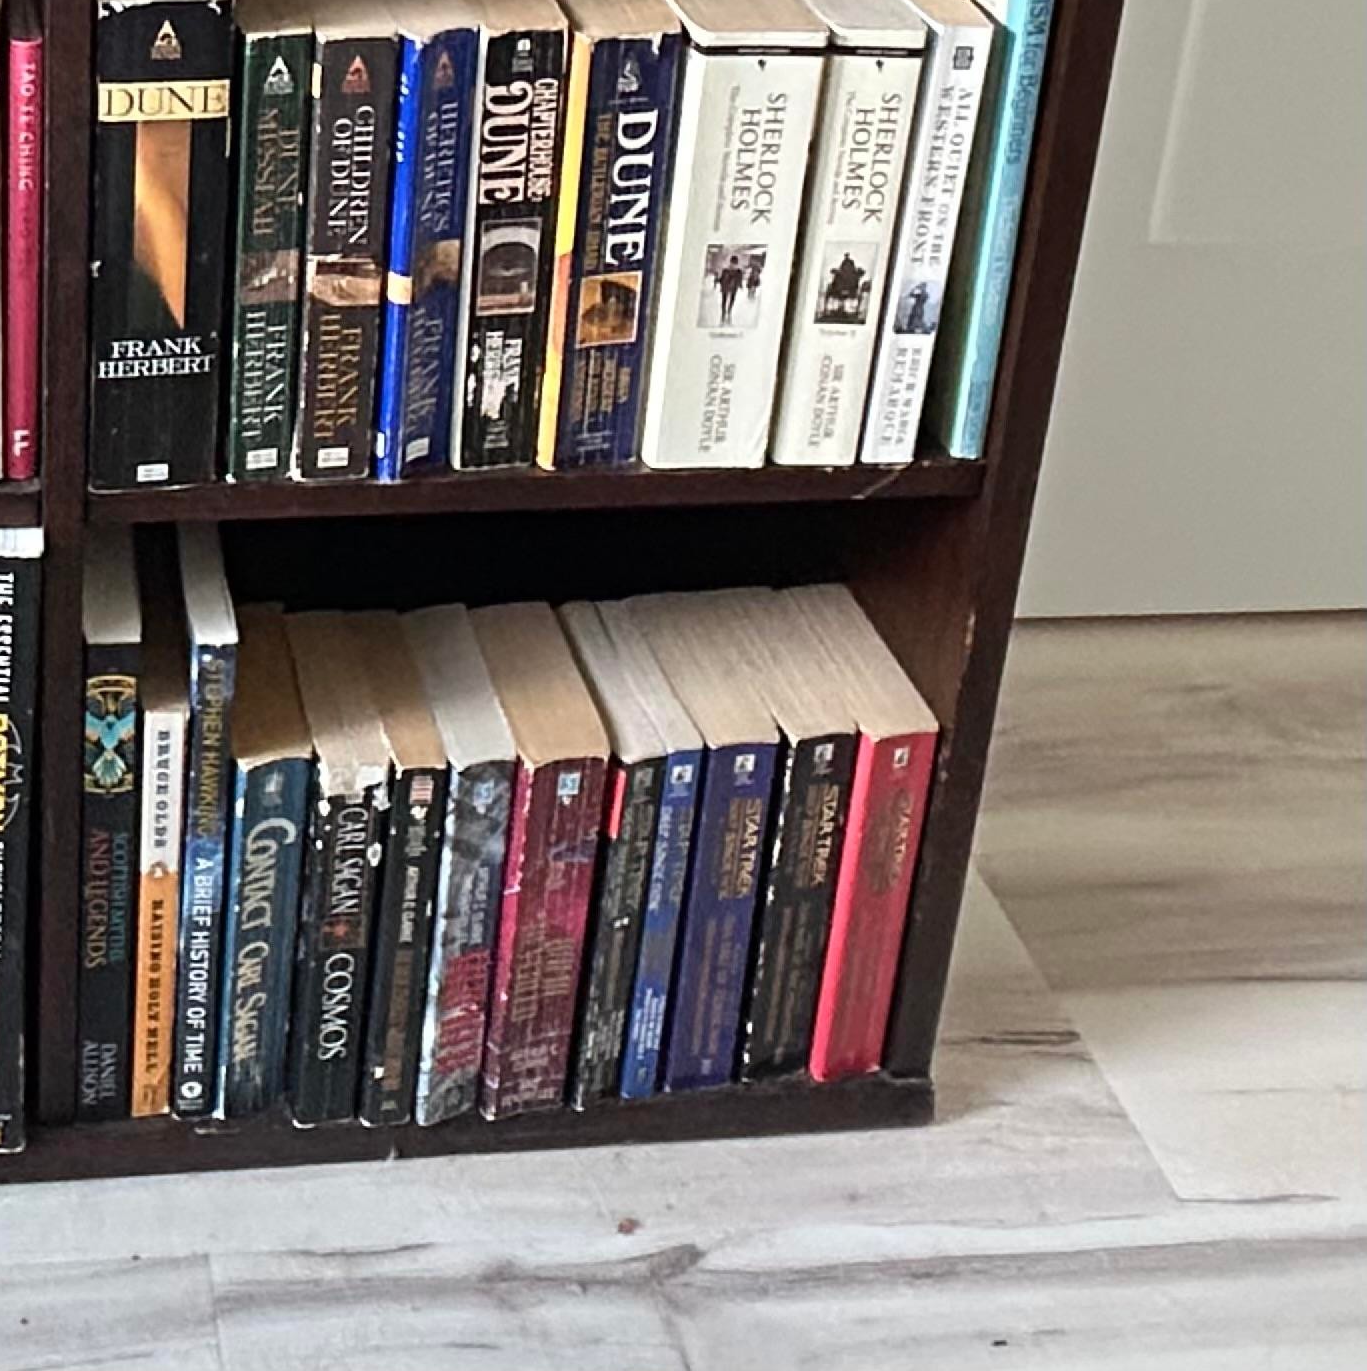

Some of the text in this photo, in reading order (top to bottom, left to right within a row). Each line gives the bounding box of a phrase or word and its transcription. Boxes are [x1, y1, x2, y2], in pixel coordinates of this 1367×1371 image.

[17, 63, 36, 191] TAO TE CHING
[105, 84, 226, 117] DUNE
[479, 80, 534, 206] DUNE
[751, 91, 788, 225] SHERLOCK
[841, 107, 876, 210] HOLMES
[861, 91, 902, 224] SHERLOCK
[1005, 74, 1040, 167] Beginners
[252, 107, 280, 235] MESSIAH
[276, 127, 301, 212] DUNE
[327, 116, 353, 237] OF DUNE
[348, 104, 375, 245] CHILDREN
[605, 108, 659, 266] DUNE
[730, 108, 763, 211] HOLMES
[911, 85, 955, 265] WESTERN FRONT
[929, 86, 974, 266] ALL QUIET THE
[98, 354, 216, 378] HERBERT
[111, 336, 202, 359] FRANK
[241, 311, 267, 438] HERBERT
[263, 324, 287, 425] FRANK
[313, 313, 342, 440] HERBERT
[335, 327, 363, 429] FRANK
[196, 659, 226, 837] STEPHEN HAWKING
[153, 800, 169, 849] OLDS
[242, 817, 296, 931] CONTACT
[330, 806, 369, 916] CARL SAGAN
[735, 798, 763, 901] STAR TREK
[810, 784, 840, 888] STAR TREK
[85, 828, 111, 970] AND LEGENDS
[145, 899, 165, 1073] RAISING HOLY HELL
[183, 857, 215, 1075] A BRIEF HISTORY OF TIME
[232, 940, 269, 1064] CARL SAGAN
[317, 952, 356, 1061] COSMOS
[82, 1039, 99, 1106] ALLISON
[98, 1043, 117, 1100] DANIEL
